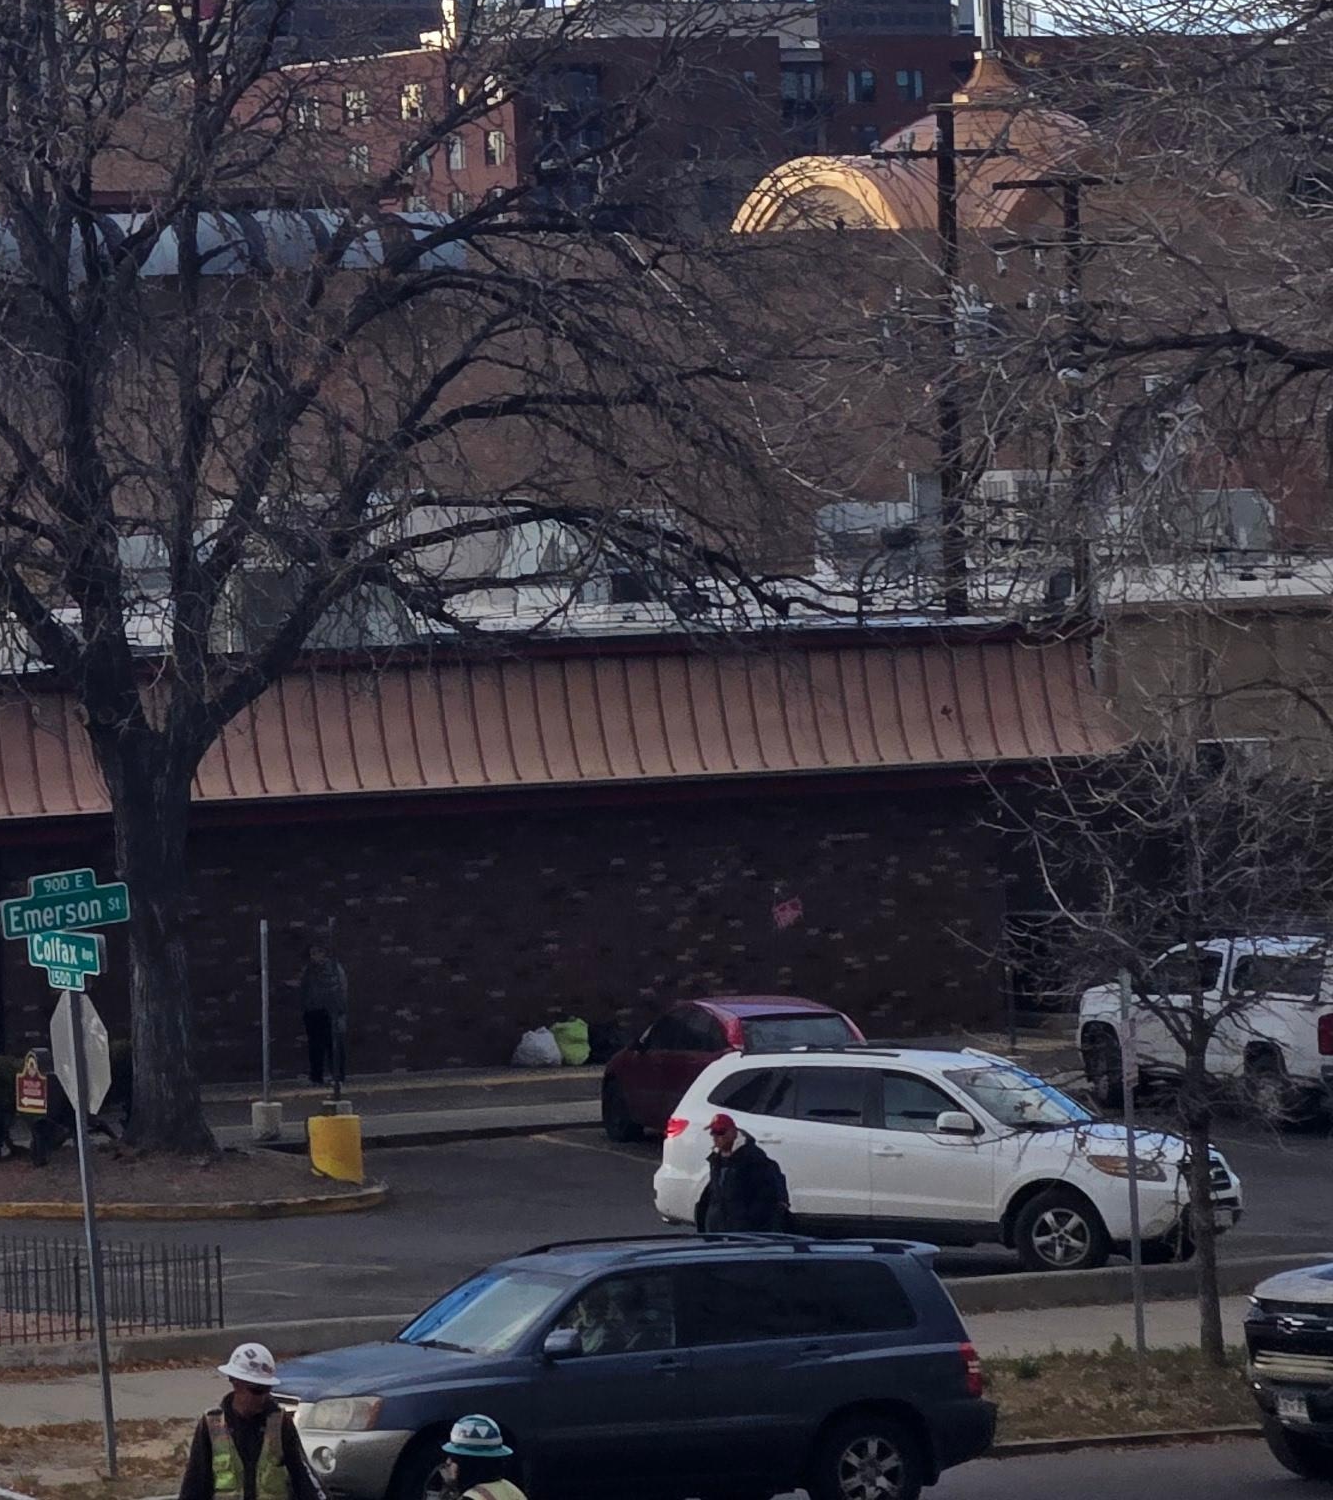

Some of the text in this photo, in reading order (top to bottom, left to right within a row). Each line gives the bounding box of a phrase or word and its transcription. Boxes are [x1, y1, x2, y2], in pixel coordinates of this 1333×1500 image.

[43, 874, 84, 893] 900 E
[9, 896, 120, 933] Emerson St
[33, 933, 94, 966] Colfax Ave
[51, 970, 82, 987] 1500 N
